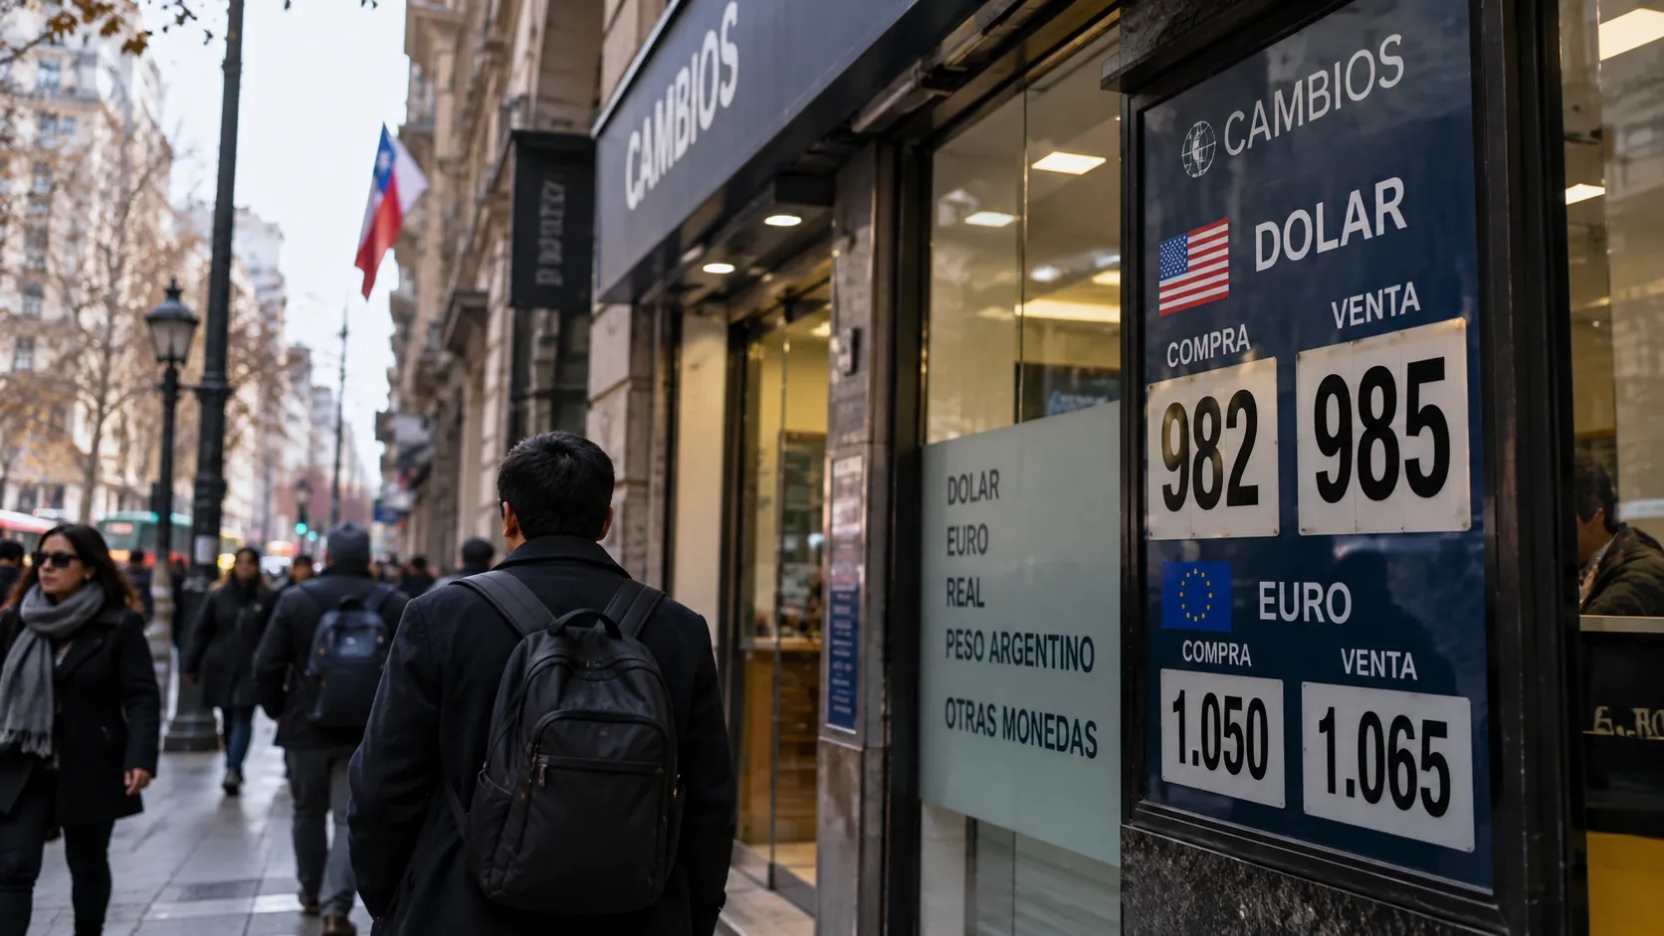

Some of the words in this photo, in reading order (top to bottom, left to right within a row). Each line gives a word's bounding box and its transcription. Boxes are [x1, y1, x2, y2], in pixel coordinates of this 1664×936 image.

[625, 1, 738, 211] CAMBIOS
[1224, 34, 1405, 156] CAMBIOS
[1255, 177, 1408, 272] DOLAR
[1331, 282, 1421, 330] VENTA
[1166, 324, 1251, 368] COMPRA
[1161, 389, 1259, 512] 982
[1314, 356, 1451, 504] 985
[947, 469, 1000, 506] DOLAR
[947, 523, 989, 557] EURO
[946, 577, 985, 608] REAL
[1259, 581, 1352, 625] EURO
[946, 628, 985, 662] PESO
[989, 630, 1096, 674] ARGENTINO
[1182, 639, 1252, 667] COMPRA
[1341, 648, 1418, 681] VENTA
[945, 696, 997, 738] OTRAS
[1002, 705, 1098, 759] MONEDAS
[1173, 689, 1269, 781] 1.050
[1318, 706, 1451, 818] 1.065
